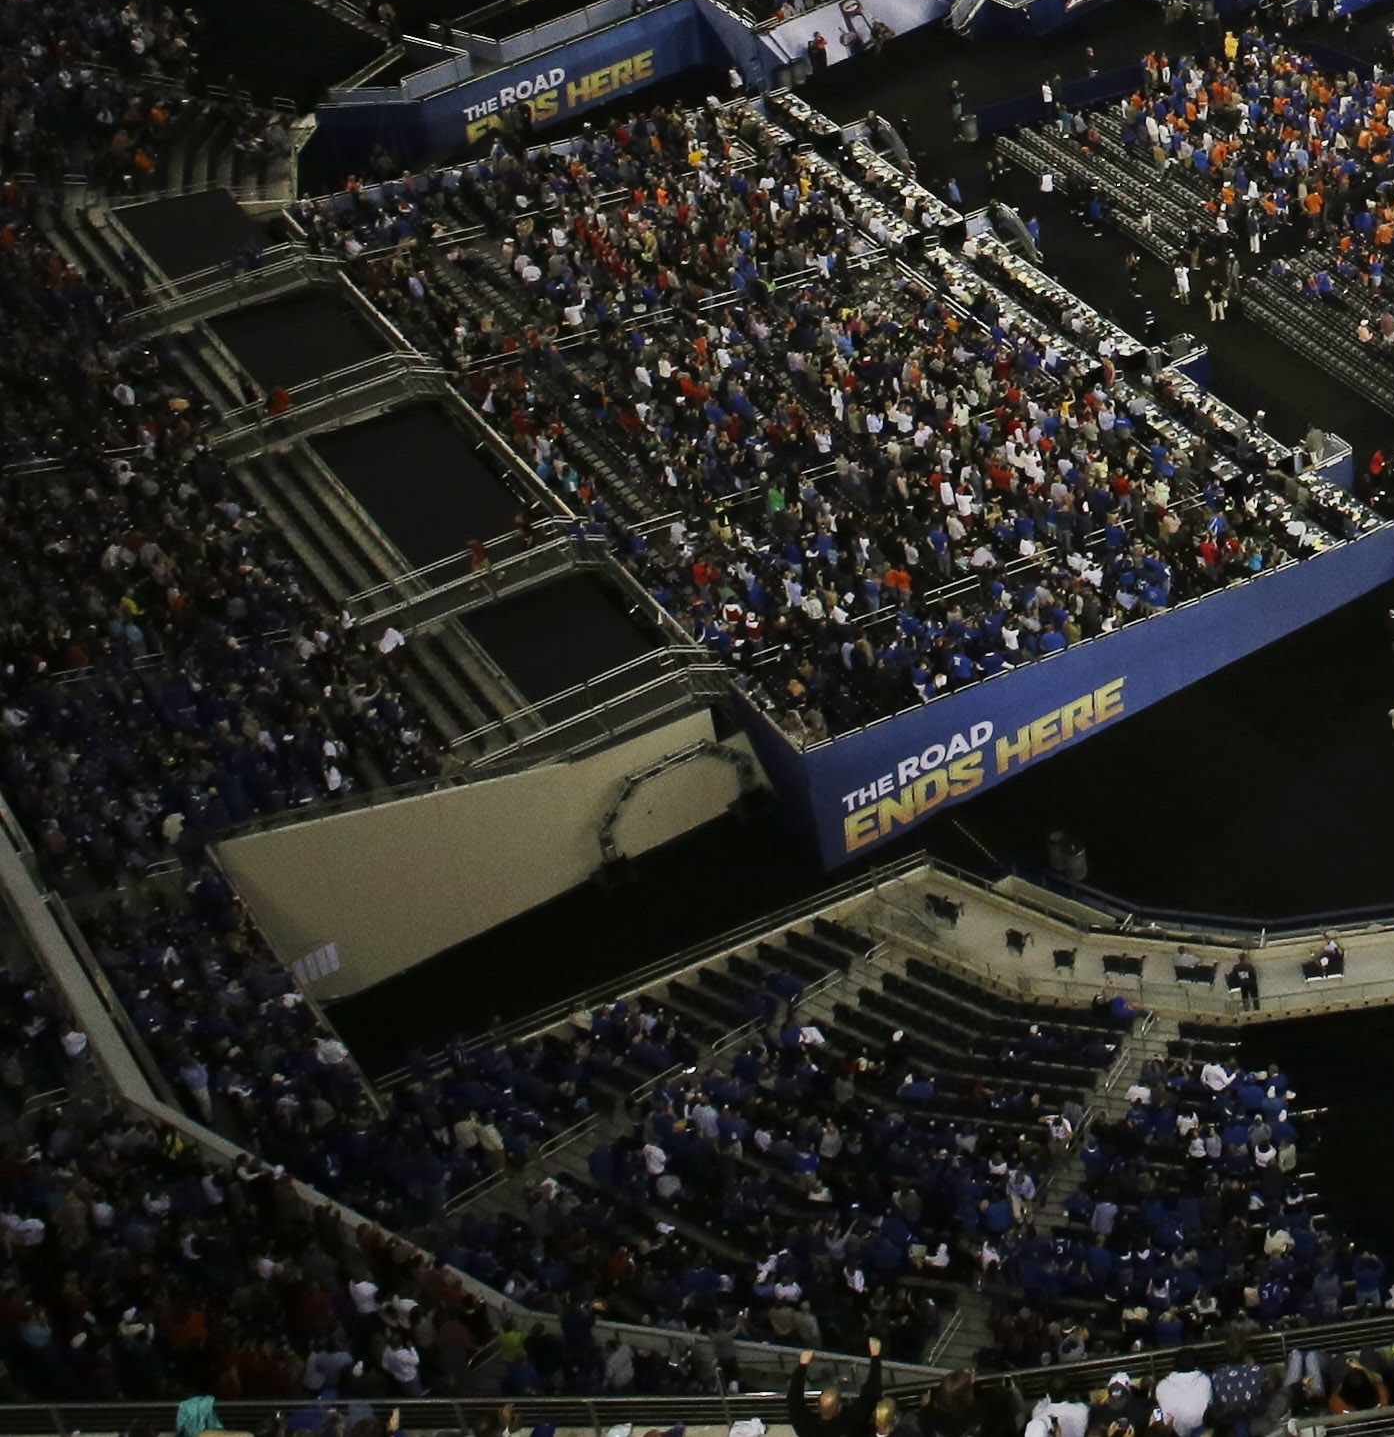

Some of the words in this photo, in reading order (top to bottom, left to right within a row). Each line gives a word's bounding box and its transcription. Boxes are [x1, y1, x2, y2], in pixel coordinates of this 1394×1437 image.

[463, 97, 499, 121] THE
[500, 67, 565, 107] ROAD
[566, 49, 654, 107] HERE
[842, 773, 895, 812] THE
[898, 720, 994, 786] ROAD
[844, 750, 984, 854] ENDS
[995, 676, 1125, 775] HERE
